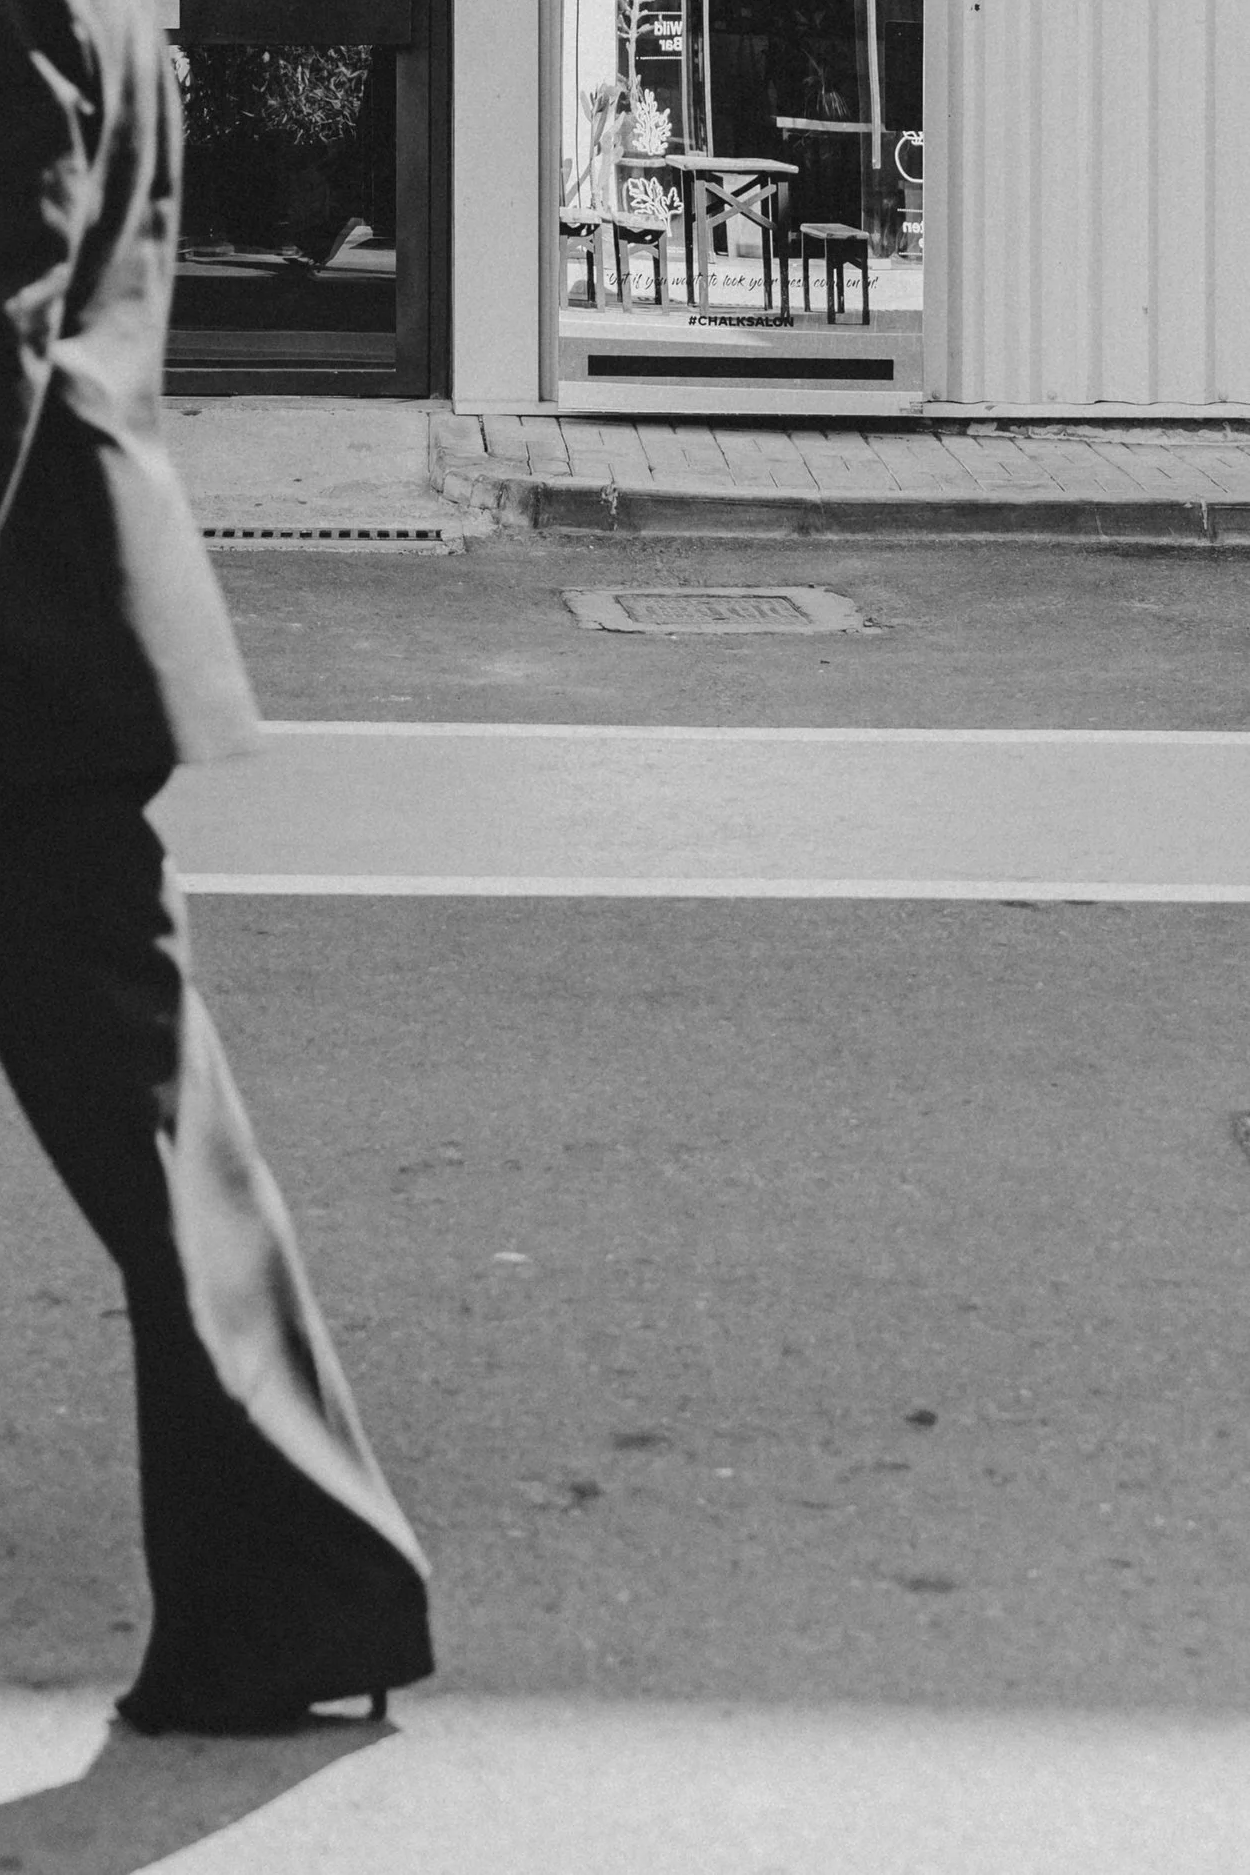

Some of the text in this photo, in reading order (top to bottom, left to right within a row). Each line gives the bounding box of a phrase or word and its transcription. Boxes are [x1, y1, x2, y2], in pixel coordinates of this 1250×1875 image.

[671, 272, 703, 286] wat
[723, 274, 746, 287] look
[749, 277, 778, 291] yor
[687, 315, 795, 328] #CHALKSALON
